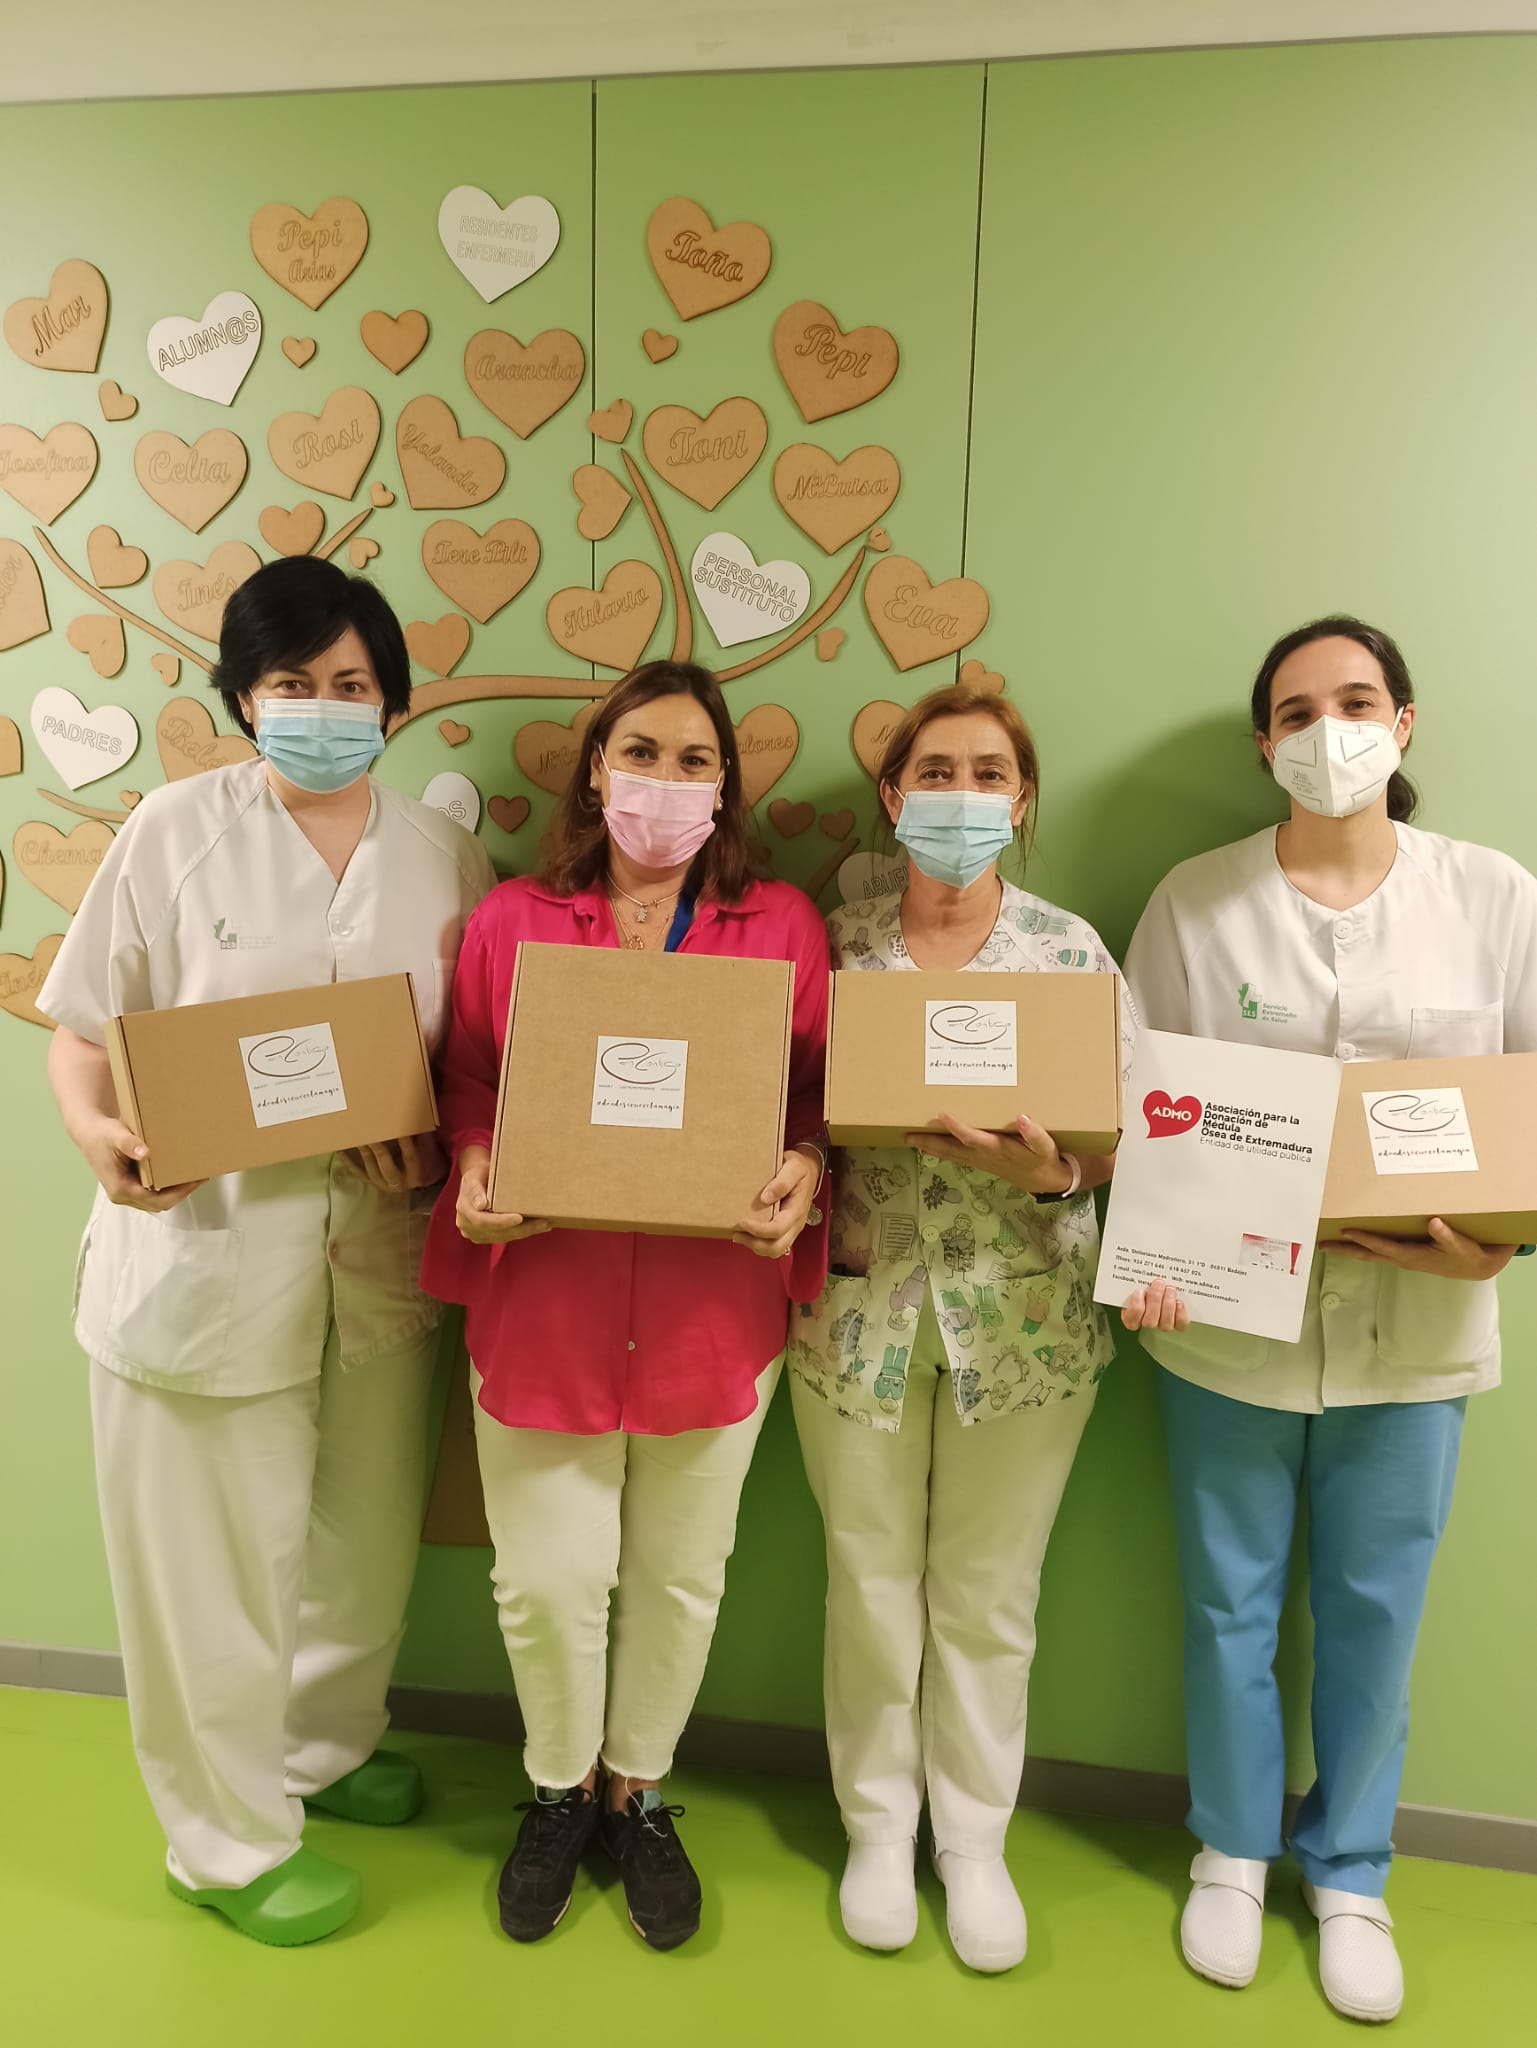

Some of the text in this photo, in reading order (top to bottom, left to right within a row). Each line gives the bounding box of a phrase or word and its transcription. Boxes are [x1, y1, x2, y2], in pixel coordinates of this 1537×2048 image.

[277, 219, 342, 259] Pepi
[459, 215, 538, 244] RESIDENTES
[288, 258, 336, 283] Arias
[664, 229, 745, 283] Toño
[31, 295, 91, 357] Mar
[157, 310, 260, 372] ALUMN@S
[475, 354, 579, 382] Arancha
[794, 323, 872, 380] Pepi
[292, 418, 365, 470] Rosi
[401, 423, 480, 497] Yolanda
[666, 426, 749, 467] Toni
[149, 449, 232, 485] Celia
[431, 539, 528, 565] Tere Pili
[177, 571, 238, 612] Inés
[694, 566, 795, 624] SUSTITUTO
[703, 551, 799, 609] PERSONAL
[563, 587, 650, 639] Hilario
[884, 584, 959, 641] Eva
[41, 714, 122, 756] PADRES
[20, 839, 103, 865] Chema
[1151, 1106, 1192, 1122] ADMO
[1202, 1117, 1241, 1133] Médula
[1203, 1110, 1269, 1129] Donación de
[1205, 1101, 1300, 1125] Asociación para la
[1200, 1137, 1312, 1164] Entidad de utilidad pública
[1229, 1130, 1243, 1142] de
[1245, 1135, 1313, 1154] Extremadura
